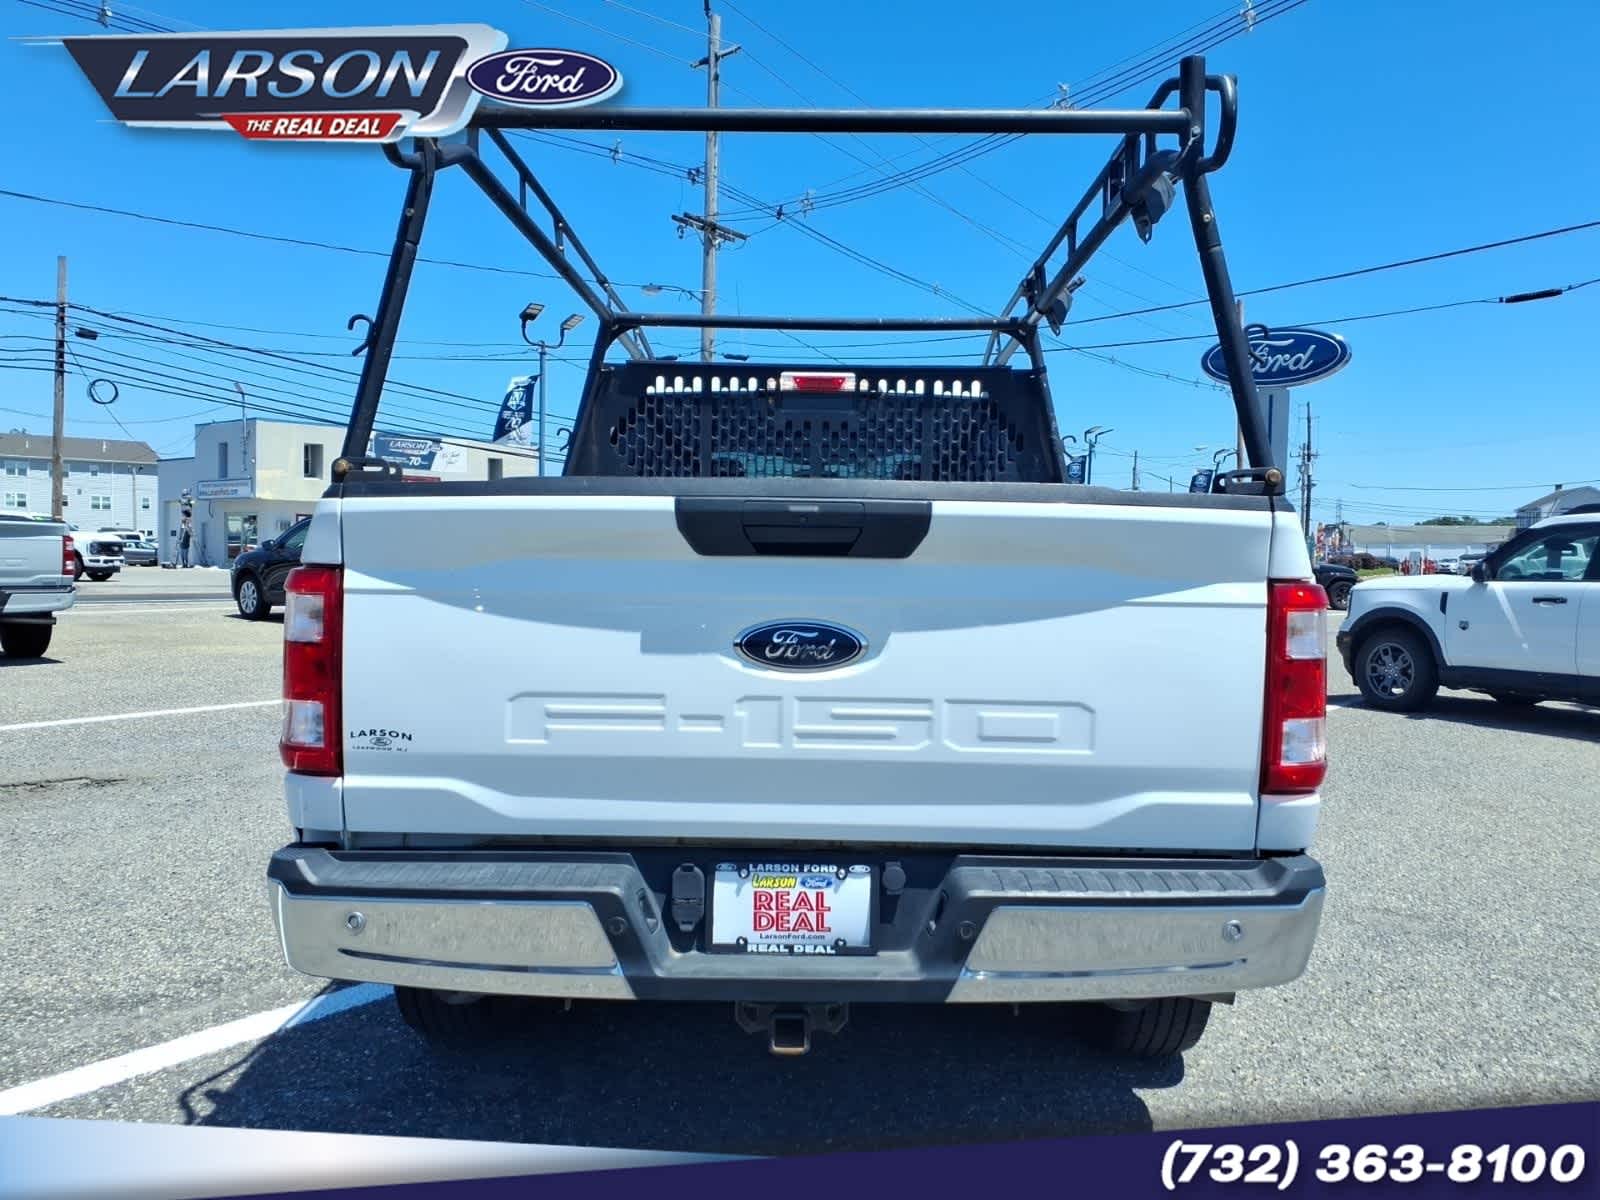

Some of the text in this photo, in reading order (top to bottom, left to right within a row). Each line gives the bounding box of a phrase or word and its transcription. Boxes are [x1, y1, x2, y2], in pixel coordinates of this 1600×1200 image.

[389, 439, 427, 451] LARSON
[408, 456, 421, 466] 70
[764, 629, 836, 661] Ford
[504, 691, 1095, 755] F-150
[350, 729, 413, 741] LARSON
[749, 863, 800, 873] LARSON
[803, 863, 838, 874] FORD
[753, 890, 831, 912] REAL
[753, 912, 831, 932] DEAL
[759, 932, 825, 941] LarsonFord.com
[747, 943, 836, 954] REAL DEAL
